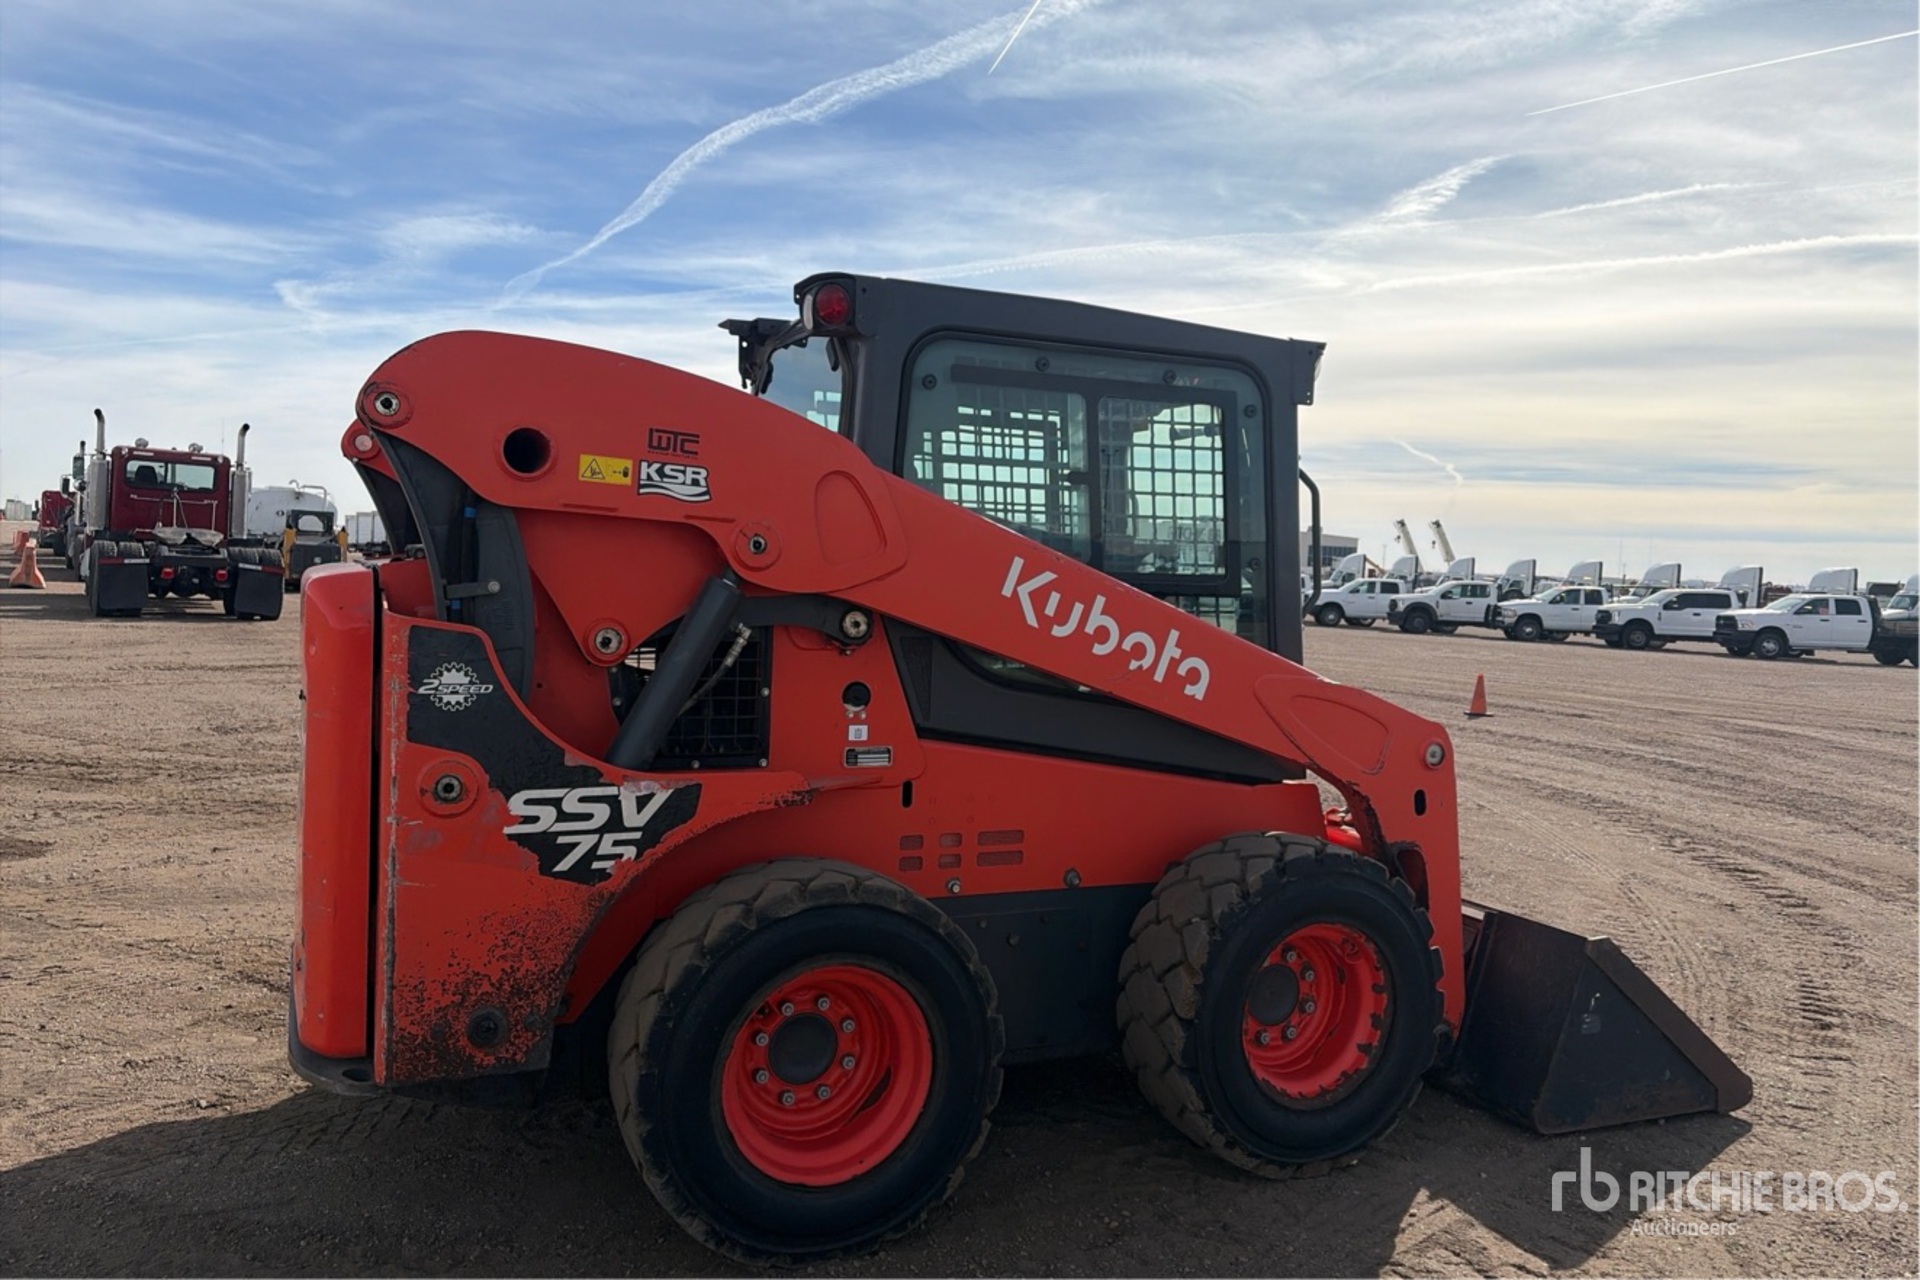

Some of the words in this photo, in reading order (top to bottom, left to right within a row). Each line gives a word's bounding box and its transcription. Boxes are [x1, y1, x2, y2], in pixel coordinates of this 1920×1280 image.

[640, 461, 708, 487] KSR
[1001, 556, 1211, 701] Kubota
[503, 786, 675, 834] SSV
[552, 832, 642, 873] 75
